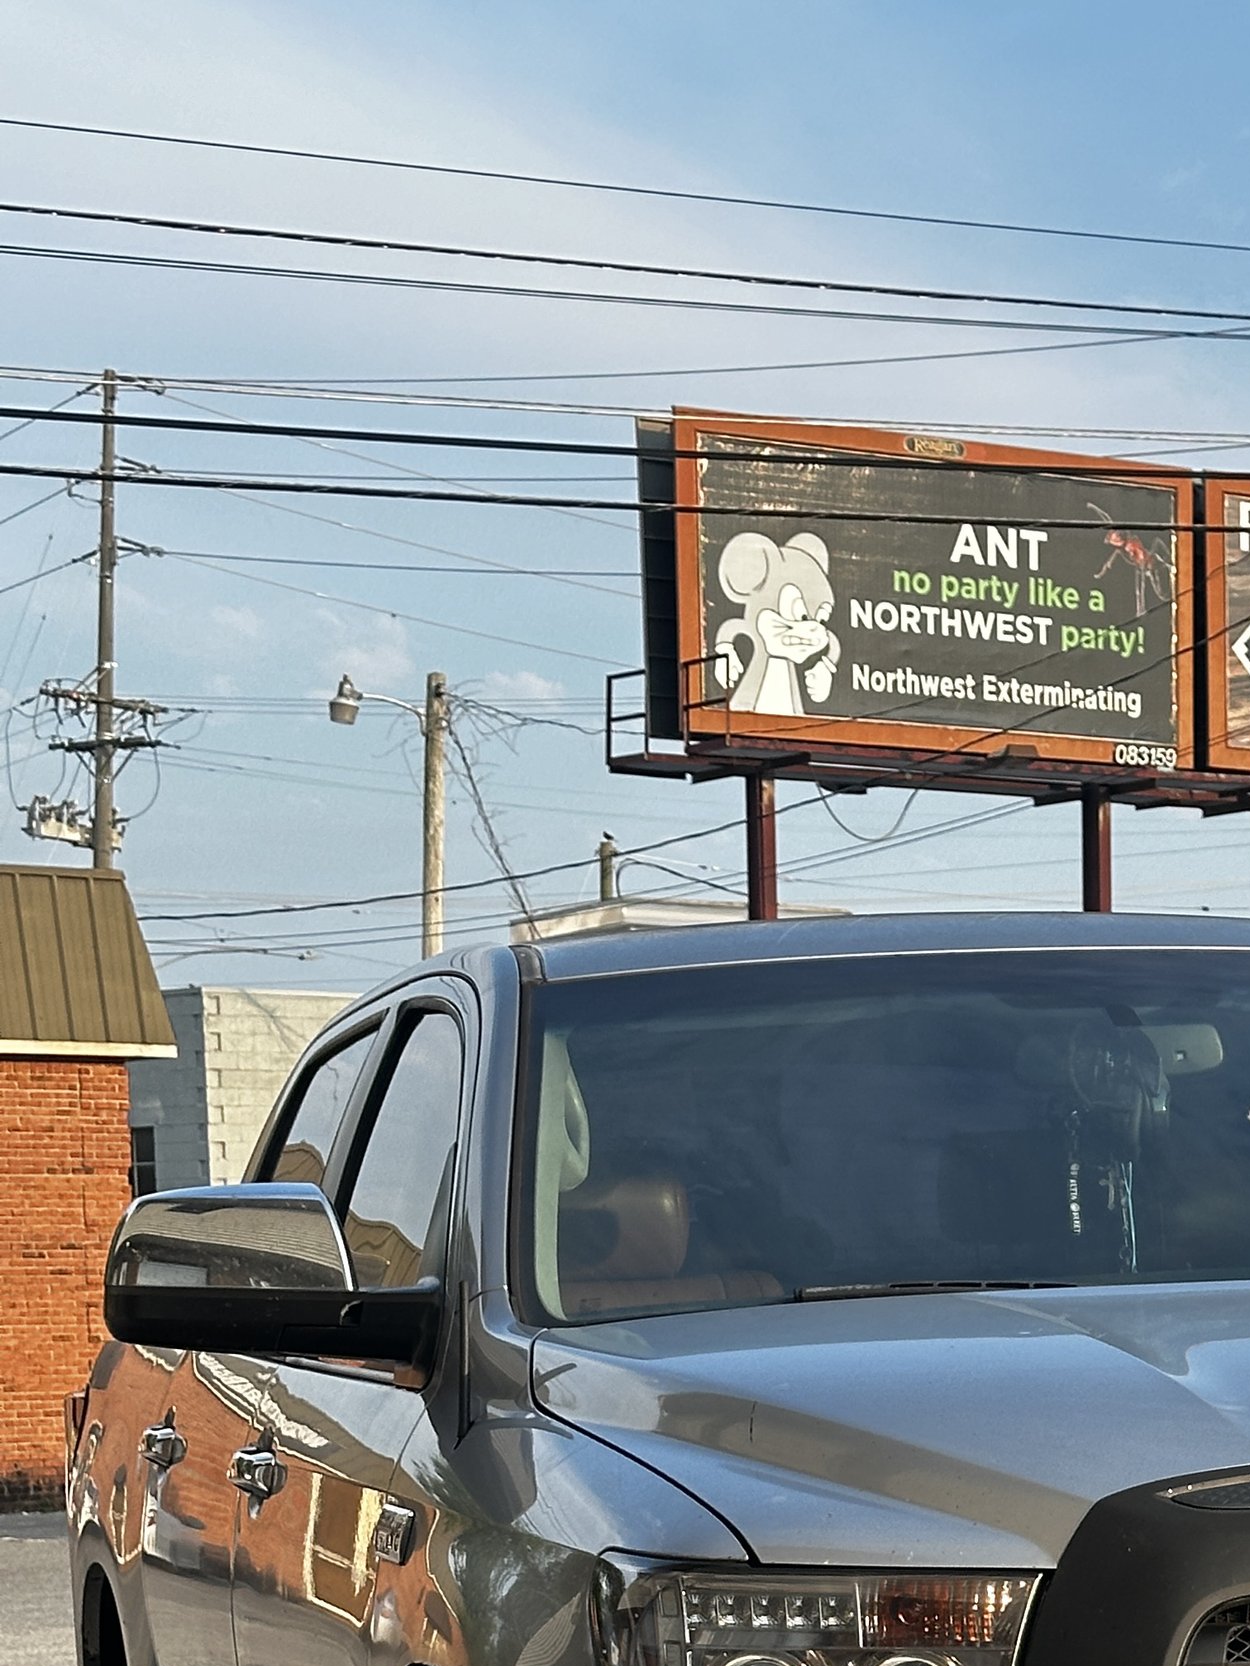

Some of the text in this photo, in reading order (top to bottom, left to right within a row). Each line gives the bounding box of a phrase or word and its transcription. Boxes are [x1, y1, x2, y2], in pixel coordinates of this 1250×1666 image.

[950, 523, 1048, 571] ANT
[893, 570, 1105, 612] no party like a
[850, 599, 1146, 658] NORTHWEST party!
[852, 663, 1143, 719] Northwest Exterminating
[1114, 744, 1177, 768] 083159
